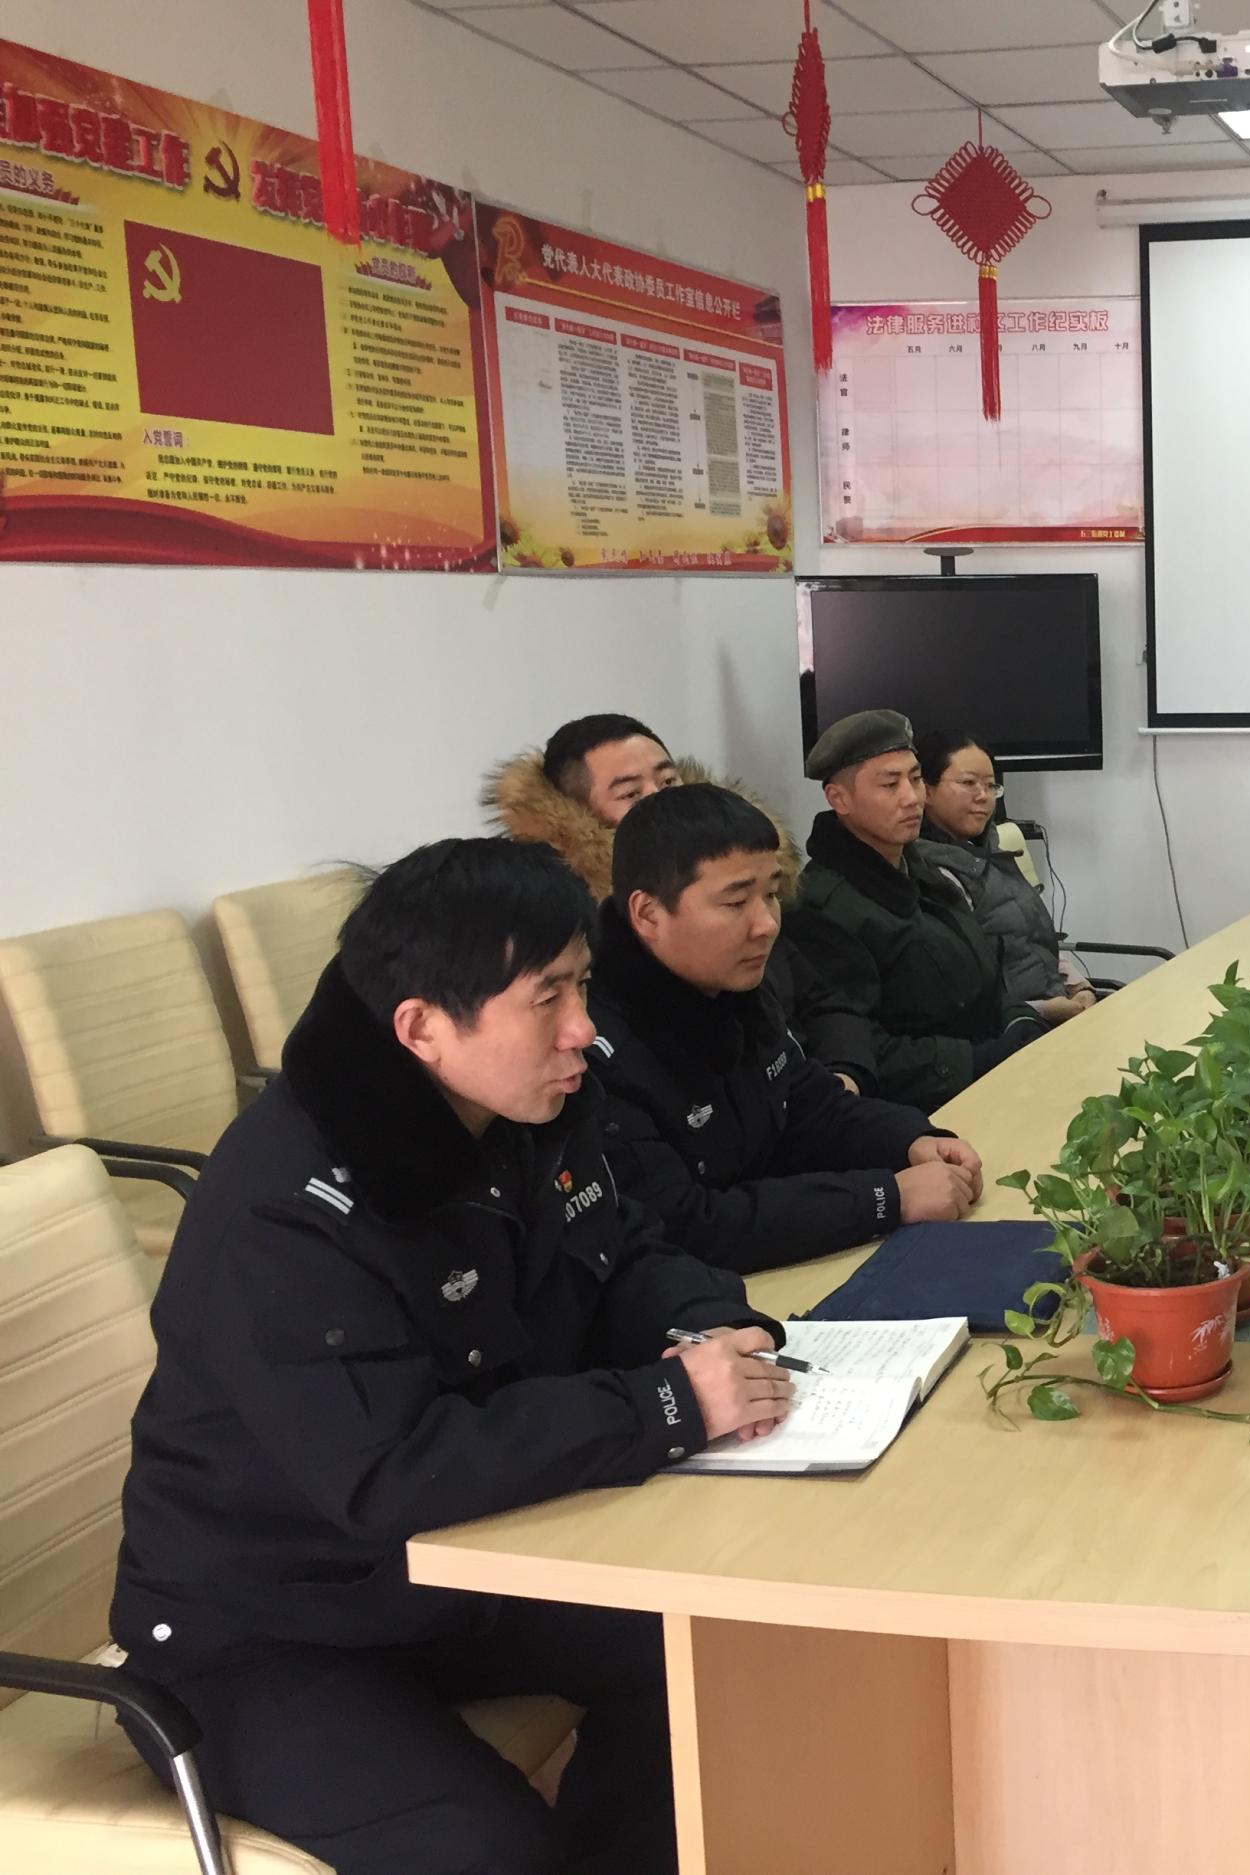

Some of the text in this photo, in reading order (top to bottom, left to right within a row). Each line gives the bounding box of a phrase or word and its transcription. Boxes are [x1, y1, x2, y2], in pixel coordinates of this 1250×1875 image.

[0, 83, 192, 191] 加强党建工作
[907, 342, 1129, 353] 五月 六月 八月 九月 十月
[873, 1186, 887, 1220] POLICE
[657, 1377, 682, 1426] POLICE
